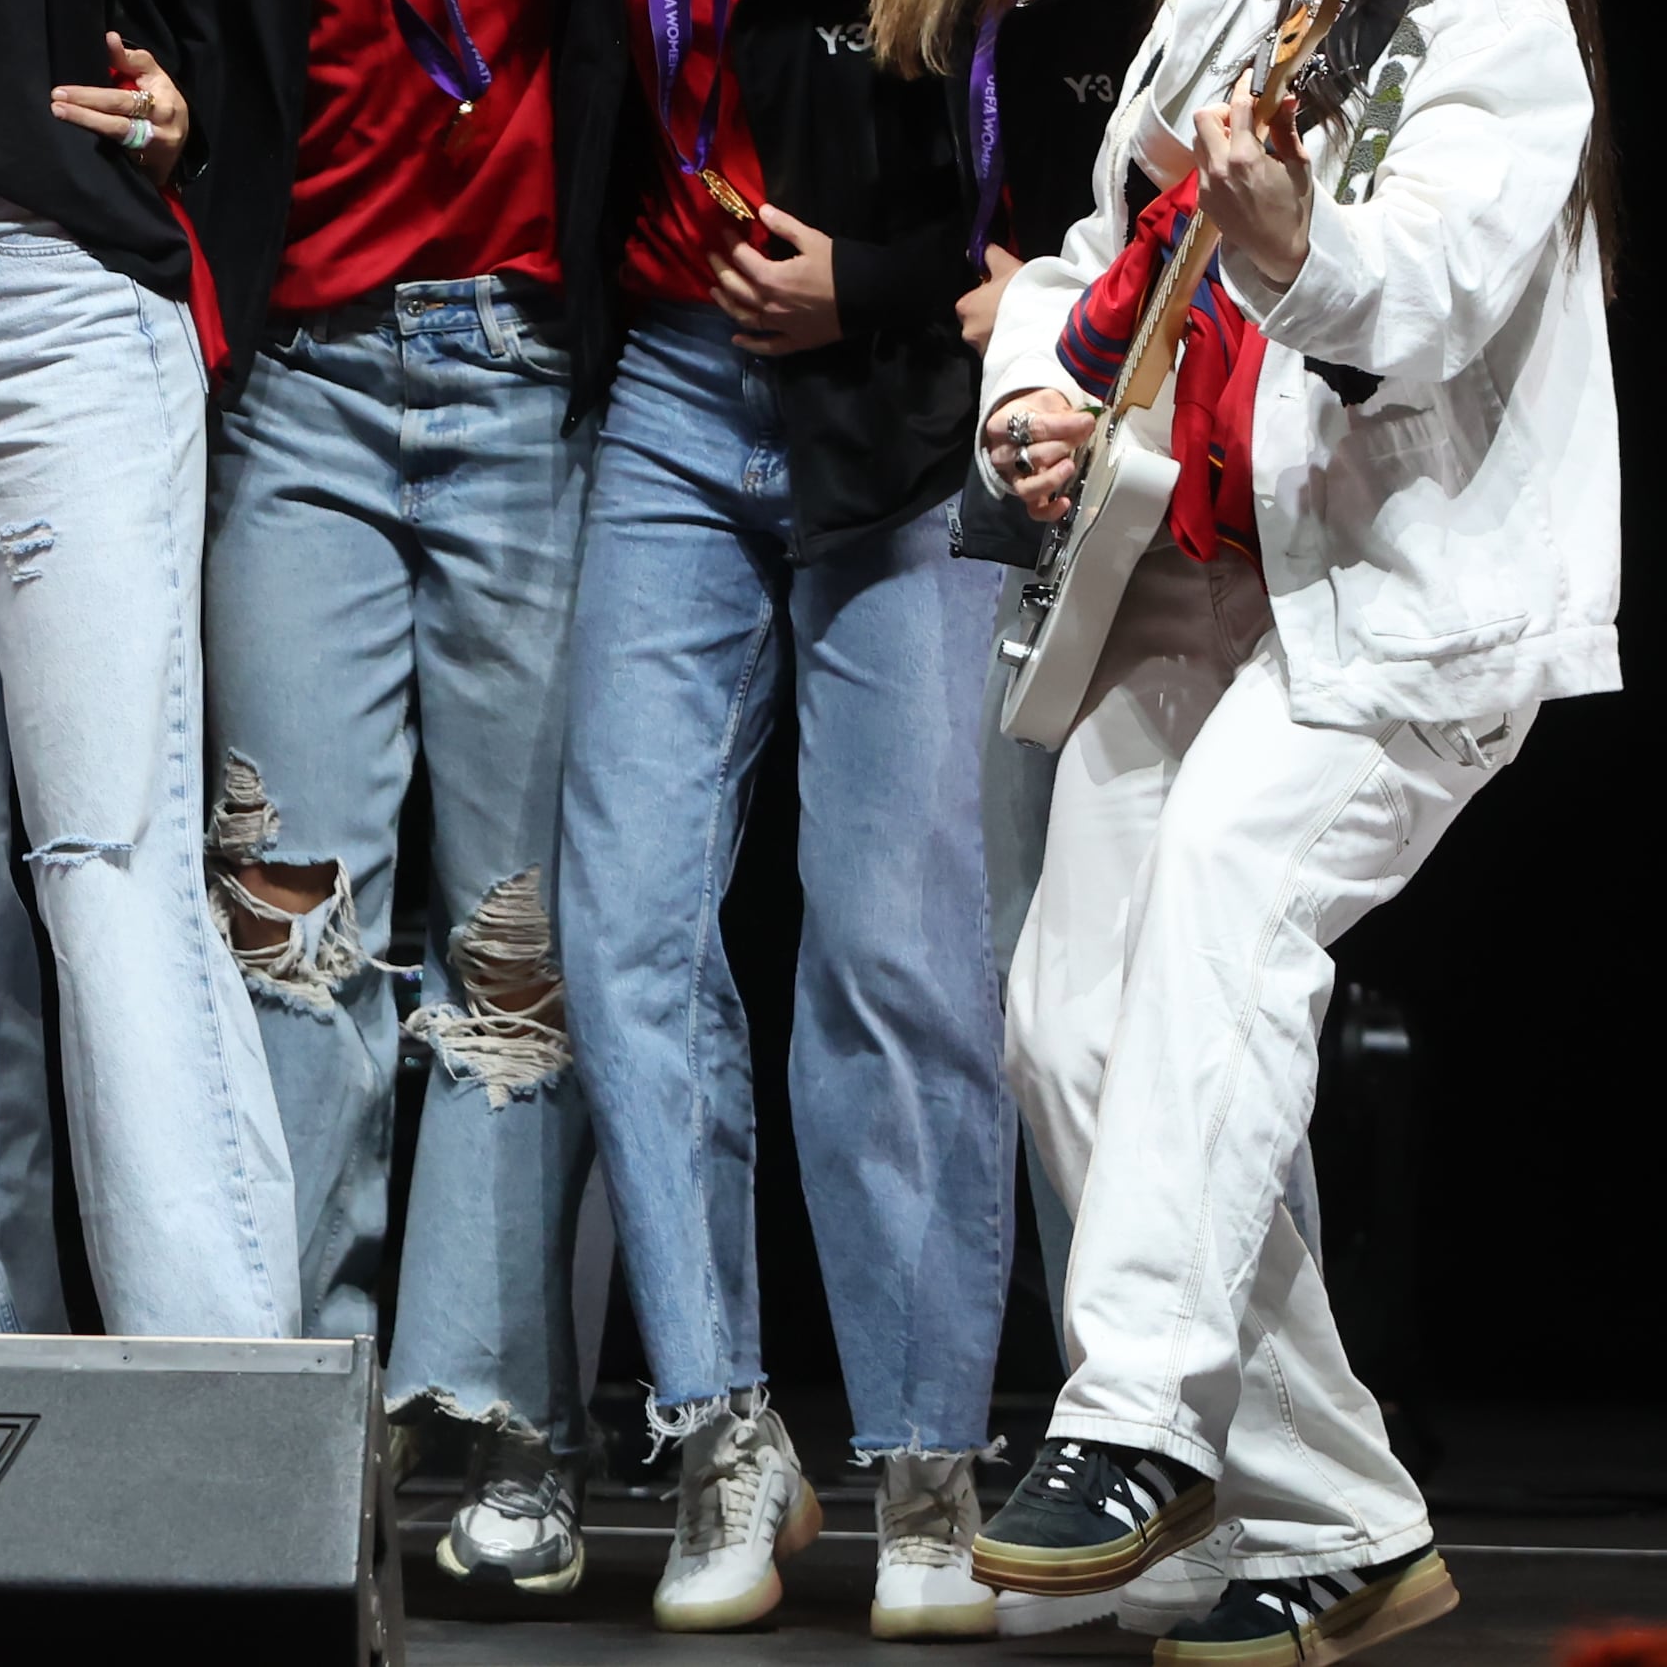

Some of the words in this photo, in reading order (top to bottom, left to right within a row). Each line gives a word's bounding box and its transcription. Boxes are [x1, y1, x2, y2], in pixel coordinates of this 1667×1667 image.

[815, 23, 873, 55] Y-3
[471, 47, 492, 84] NATI
[1062, 73, 1116, 104] Y-3
